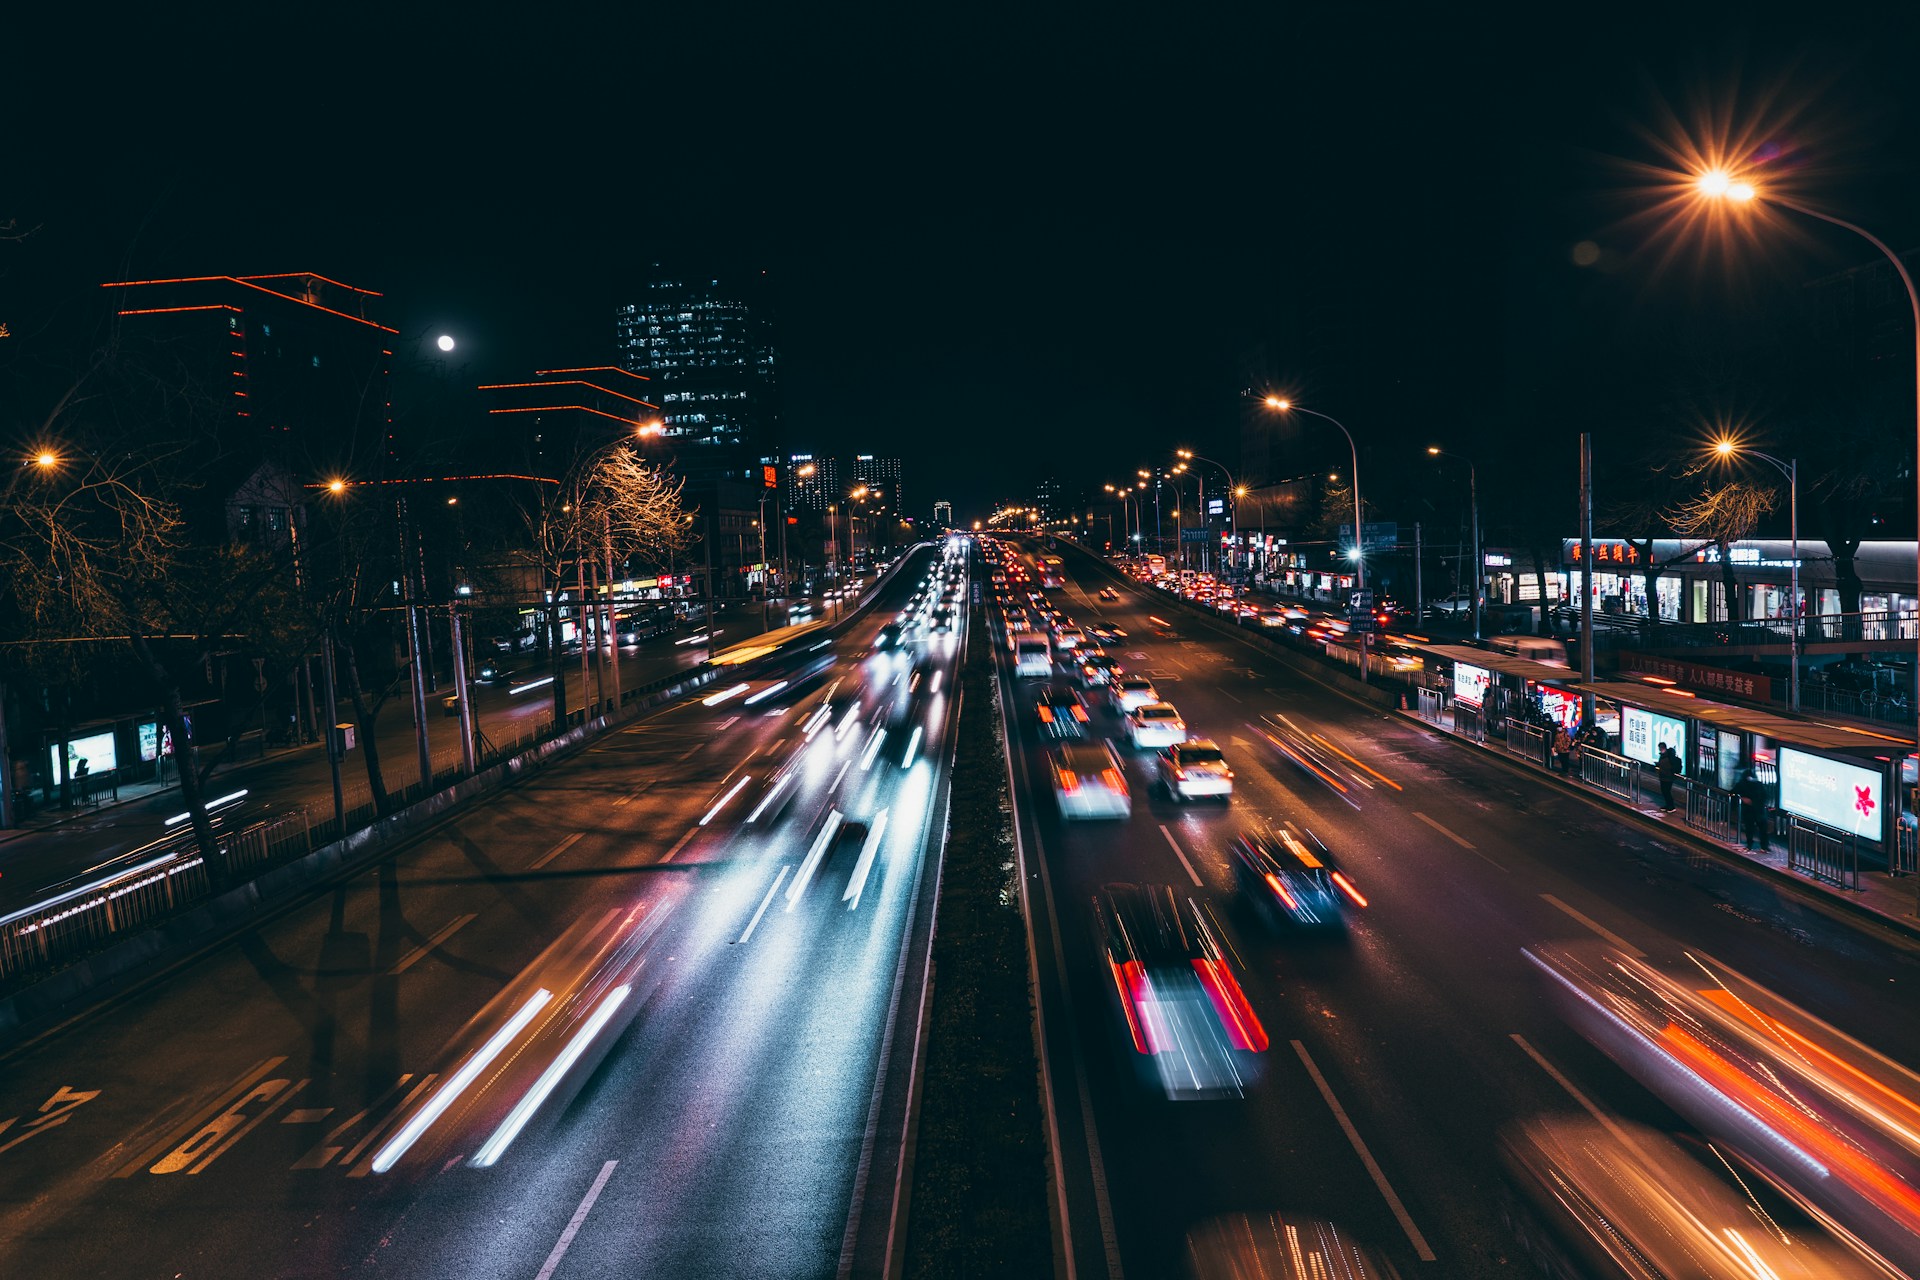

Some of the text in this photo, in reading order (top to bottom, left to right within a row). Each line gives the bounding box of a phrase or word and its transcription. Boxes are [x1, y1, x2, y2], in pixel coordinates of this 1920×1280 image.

[1689, 668, 1755, 695] 人人都是受益者
